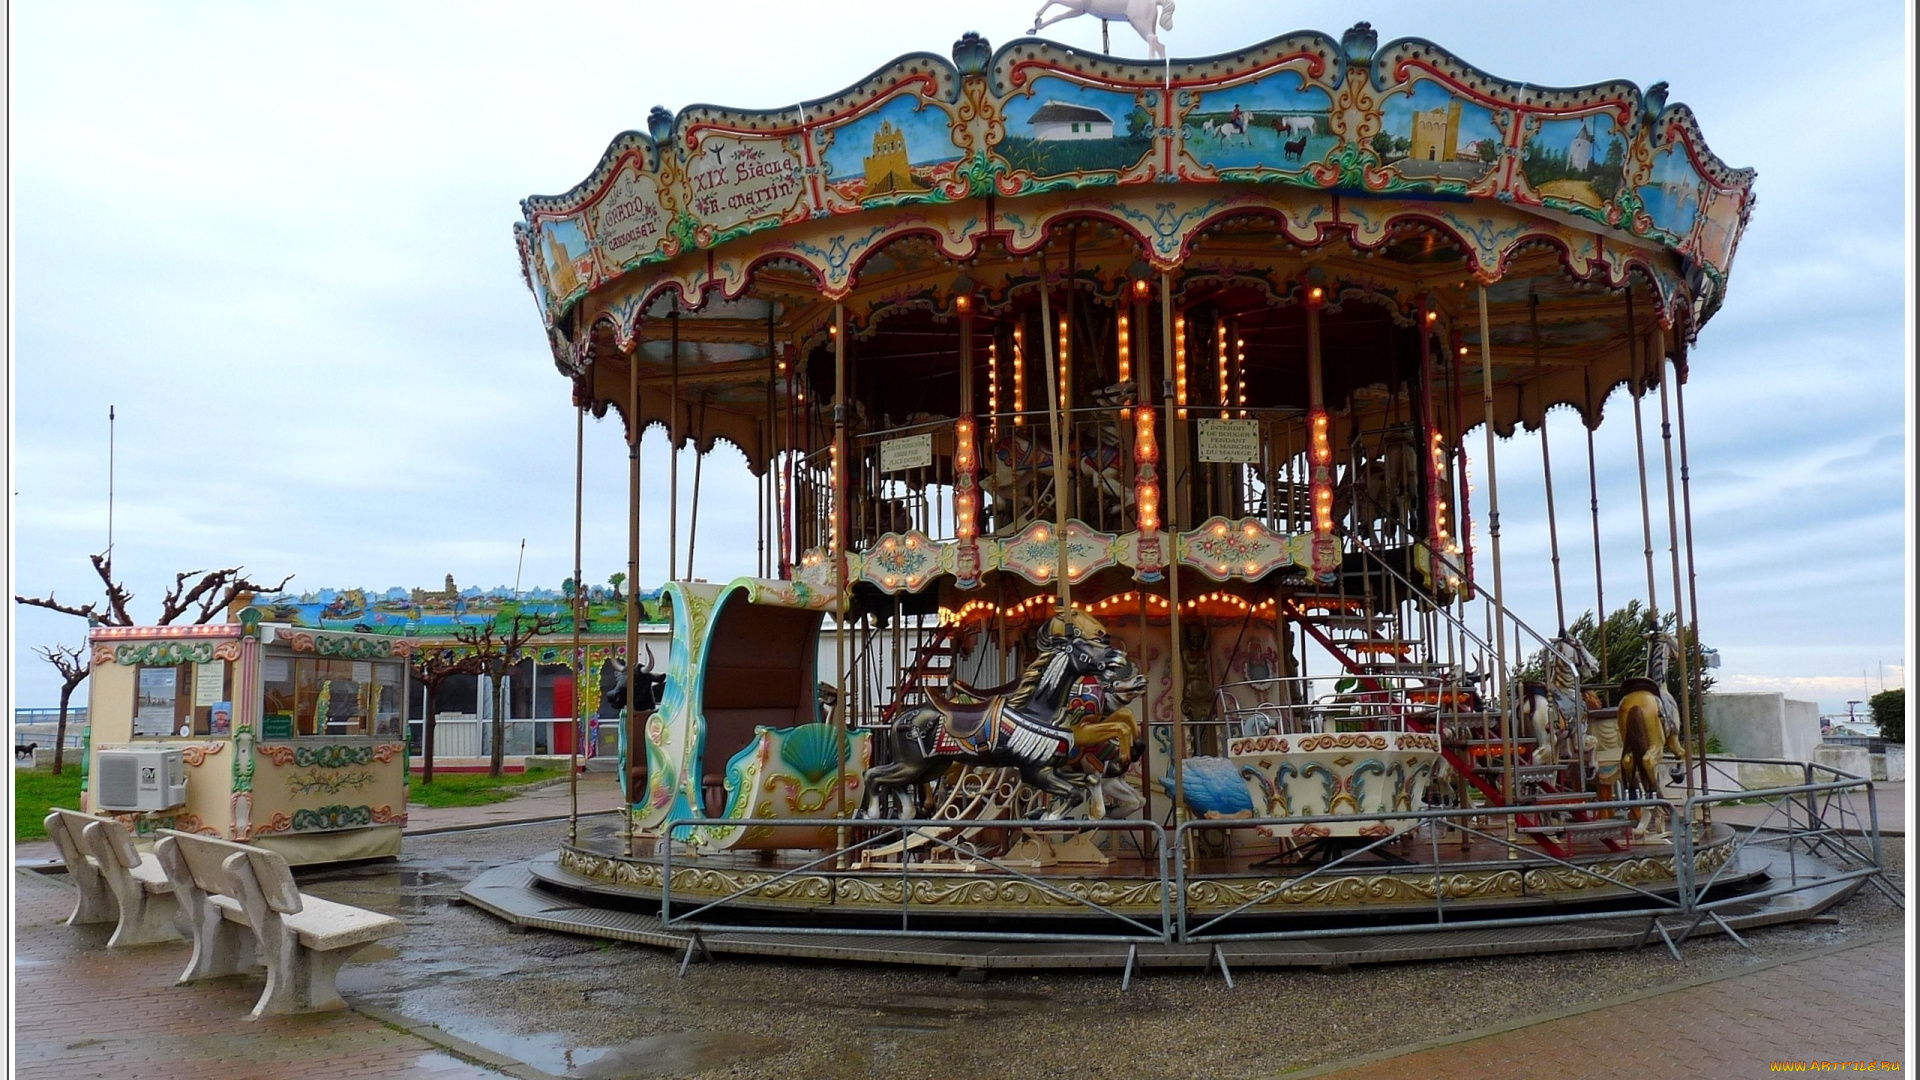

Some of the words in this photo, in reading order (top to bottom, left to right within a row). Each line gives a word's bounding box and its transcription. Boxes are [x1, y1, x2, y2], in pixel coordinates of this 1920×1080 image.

[694, 166, 729, 193] XIX
[605, 195, 643, 227] GRAND
[608, 221, 657, 251] CARROUSEL
